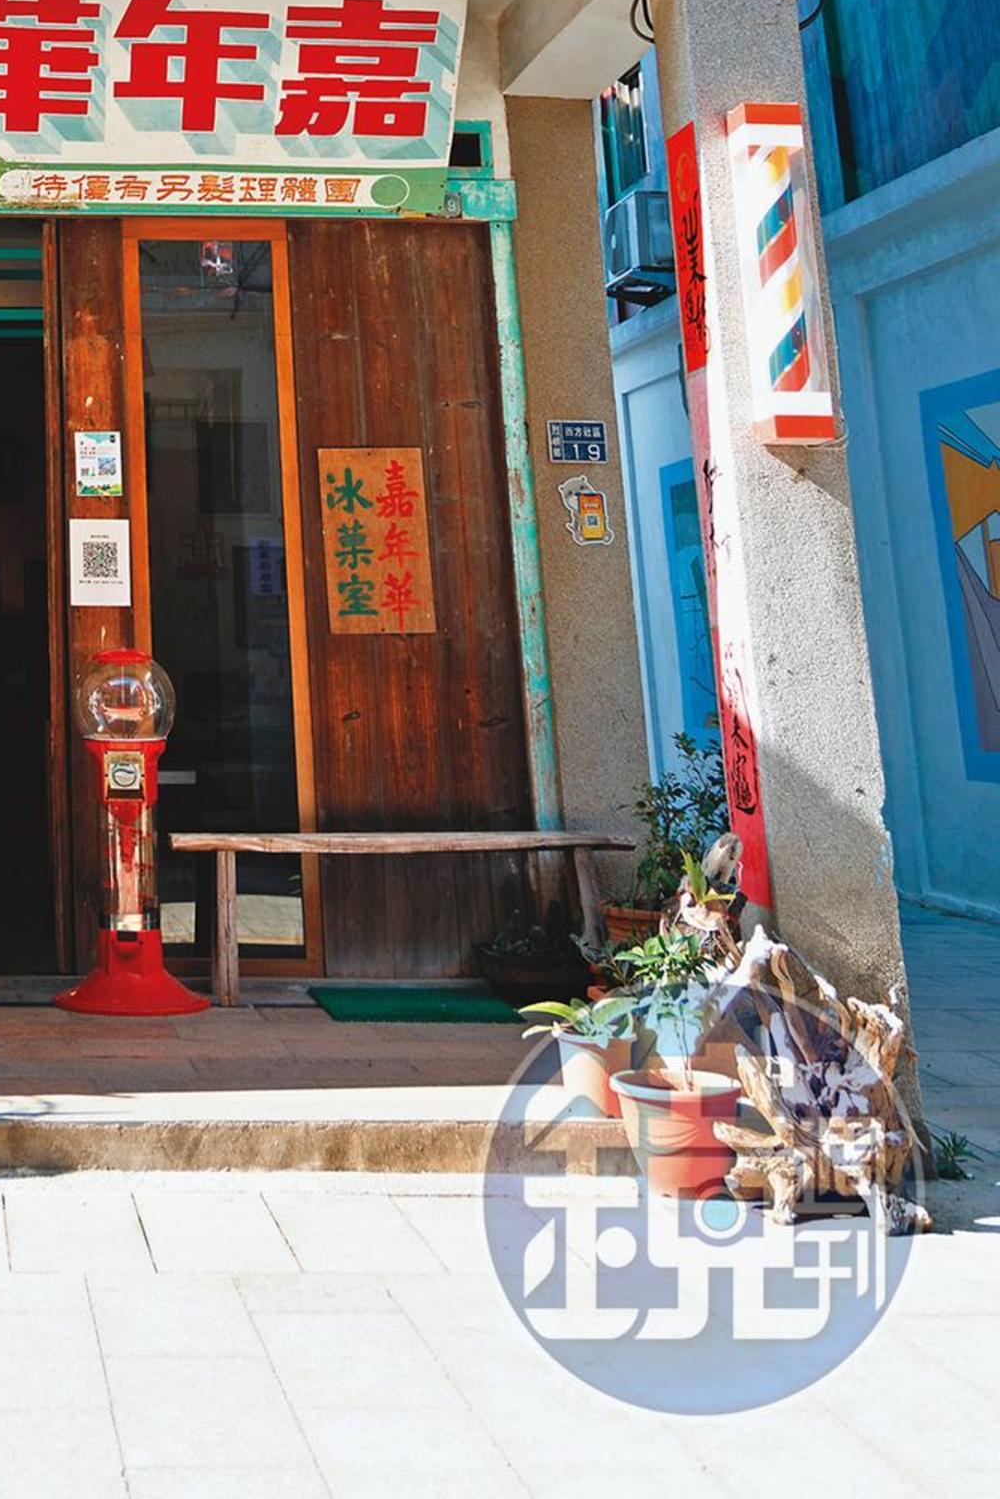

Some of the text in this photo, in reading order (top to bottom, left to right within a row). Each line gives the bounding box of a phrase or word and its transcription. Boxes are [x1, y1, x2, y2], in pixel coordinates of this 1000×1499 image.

[572, 444, 601, 461] 19
[376, 459, 421, 635] 嘉年華
